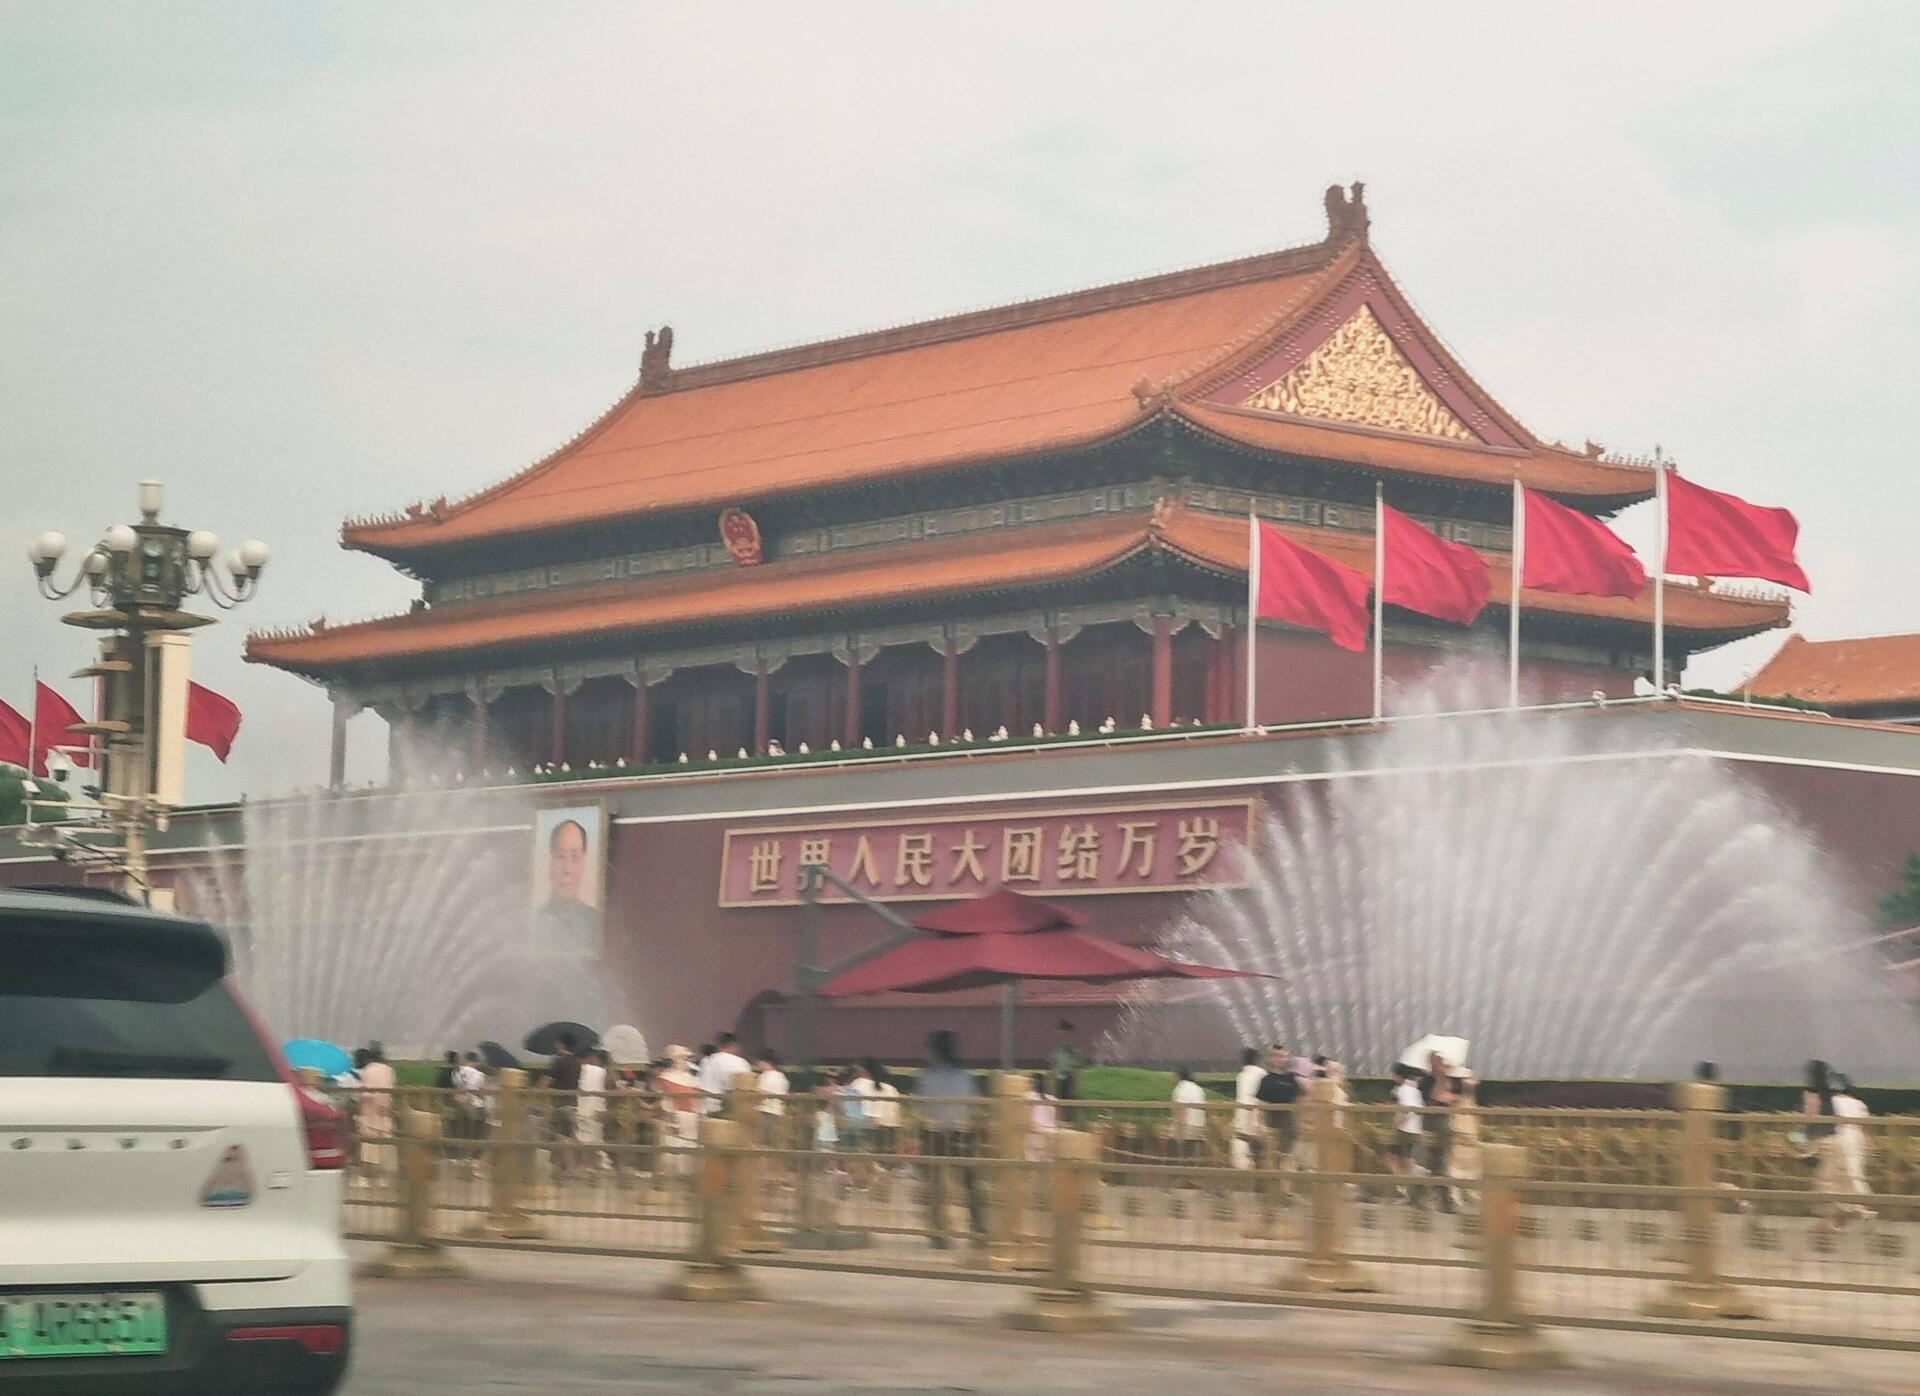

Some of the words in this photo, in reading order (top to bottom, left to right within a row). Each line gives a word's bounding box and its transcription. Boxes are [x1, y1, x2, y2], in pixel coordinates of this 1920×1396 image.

[749, 816, 1219, 892] 世界人民大团结万岁
